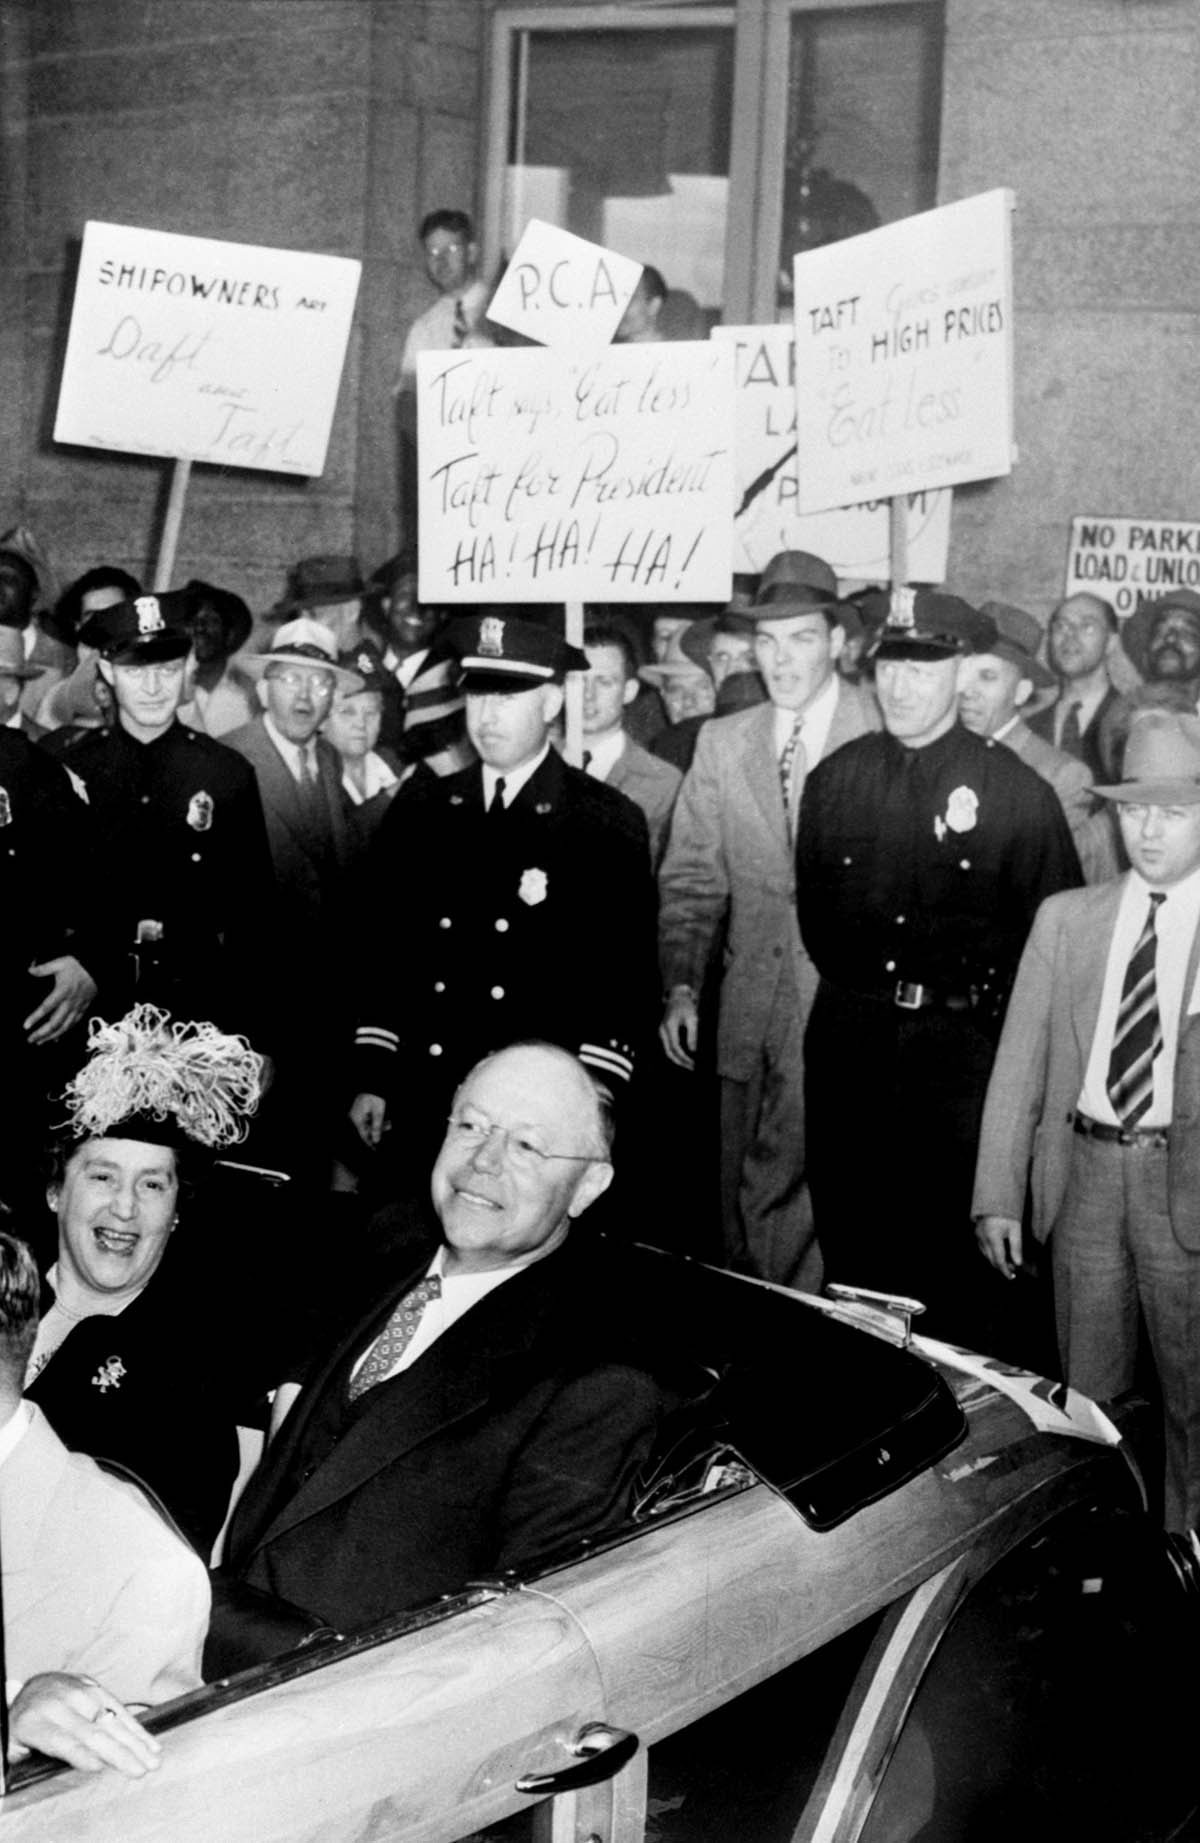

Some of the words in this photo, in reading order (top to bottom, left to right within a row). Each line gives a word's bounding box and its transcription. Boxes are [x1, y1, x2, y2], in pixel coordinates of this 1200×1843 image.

[97, 260, 280, 311] SHIPOWNERS
[808, 295, 861, 335] TAFT
[871, 318, 930, 364] HIGH
[97, 315, 215, 383] Daft
[429, 359, 503, 444] Taft
[210, 402, 305, 464] Taft
[429, 452, 503, 528] Taft
[504, 451, 562, 522] for
[570, 431, 727, 509] President
[446, 531, 520, 587] HA!
[523, 511, 601, 579] HA!
[601, 526, 706, 590] HA!
[1080, 525, 1115, 549] NO
[1075, 553, 1128, 581] LOAD
